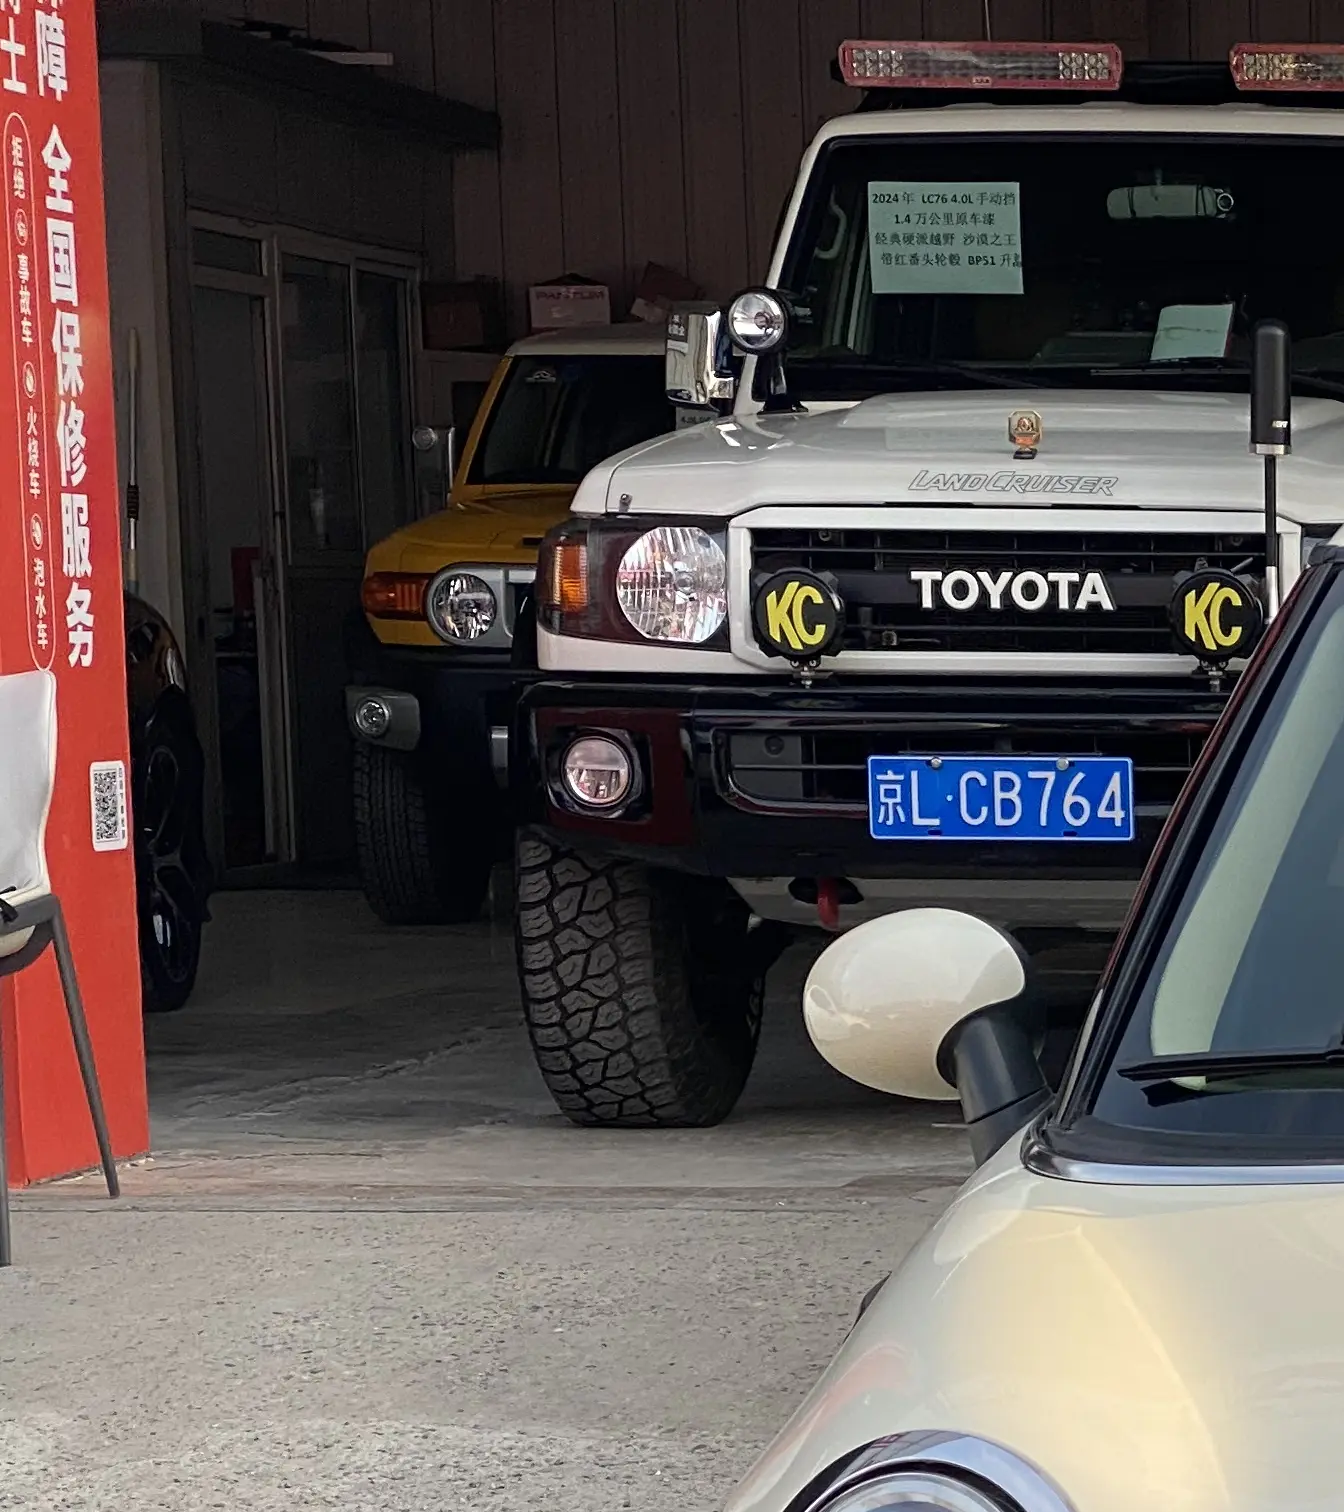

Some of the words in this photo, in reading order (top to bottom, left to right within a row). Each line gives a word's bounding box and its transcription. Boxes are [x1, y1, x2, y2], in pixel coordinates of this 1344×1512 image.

[35, 0, 68, 101] 障
[872, 193, 899, 204] 2024
[902, 192, 914, 206] 年
[921, 194, 948, 204] LC76
[950, 194, 974, 204] 4.0L
[976, 192, 1016, 206] 手动挡
[894, 214, 911, 225] 1.4
[963, 232, 1017, 246] 沙漠之王
[41, 124, 95, 667] 全国保修服务
[17, 252, 33, 348] 事故车
[26, 405, 41, 500] 火烧车
[34, 557, 49, 651] 泡水车
[908, 469, 989, 491] LAND
[985, 471, 1119, 496] CRUISER
[766, 580, 827, 650] KC
[911, 570, 1117, 612] TOYOTA
[1184, 581, 1243, 650] KC
